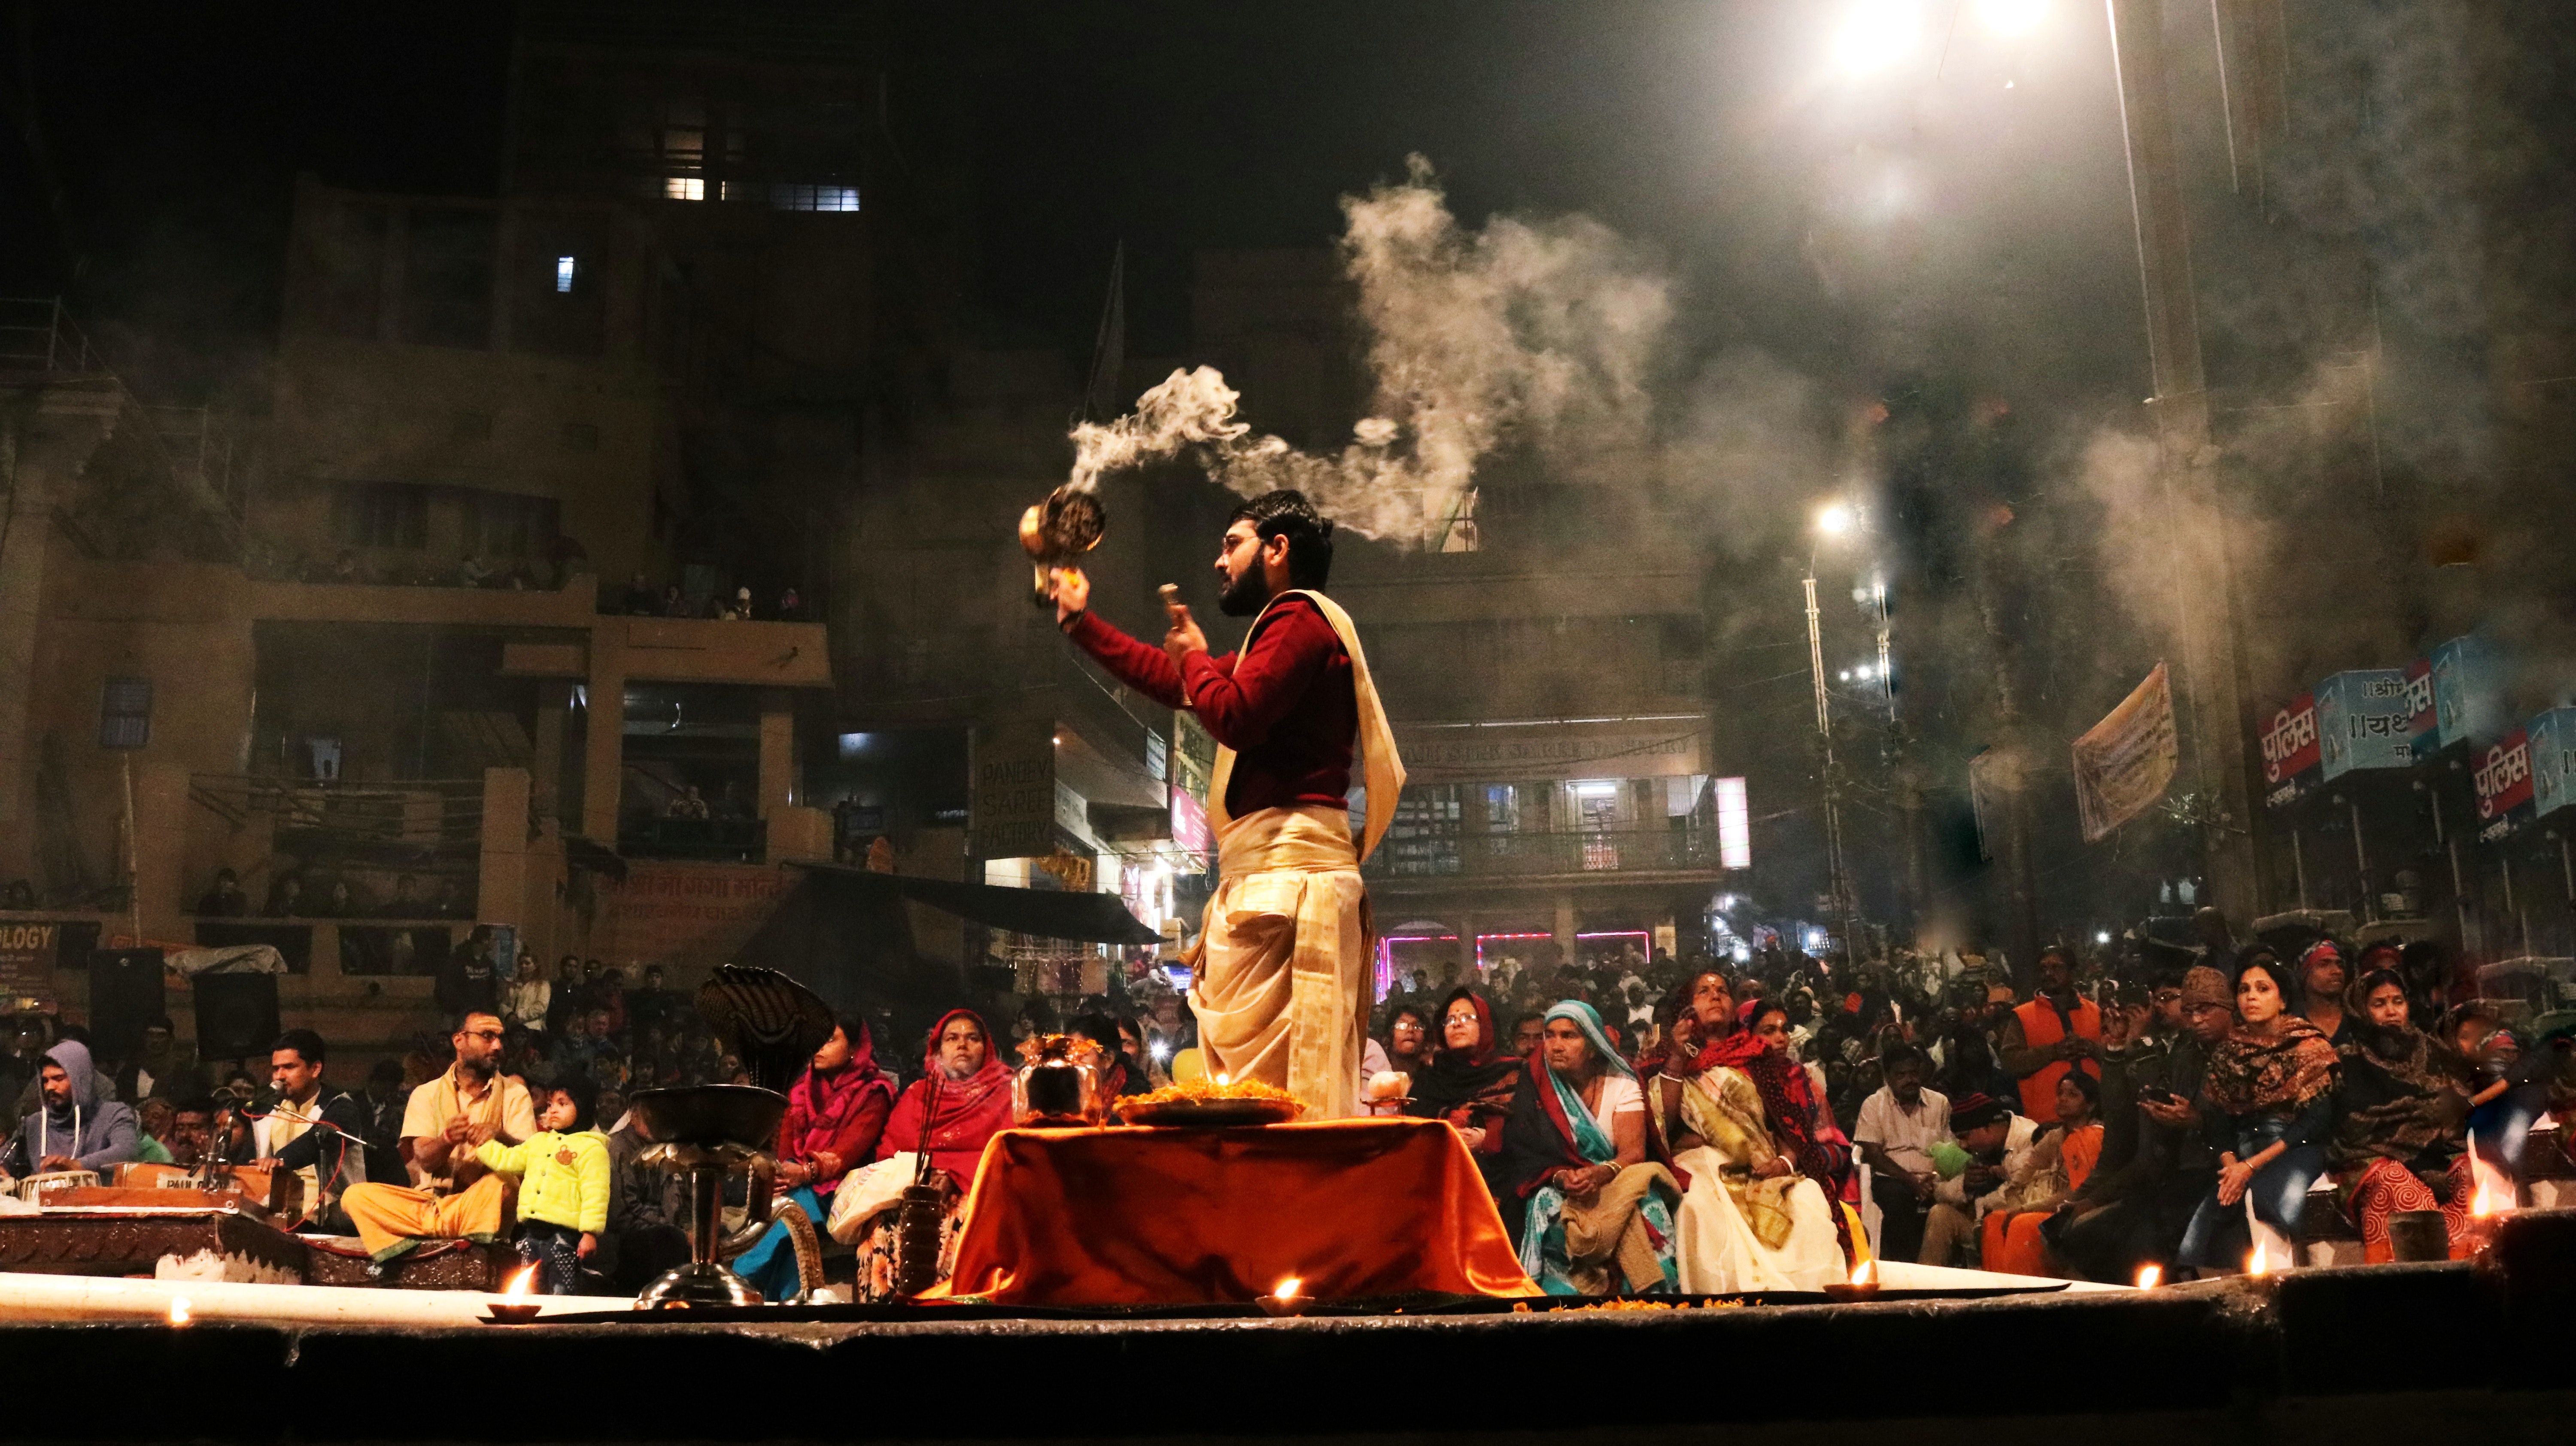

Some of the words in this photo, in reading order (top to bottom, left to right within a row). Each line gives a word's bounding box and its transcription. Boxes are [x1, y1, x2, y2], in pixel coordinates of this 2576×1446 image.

[2261, 708, 2316, 784] पुलिस
[982, 759, 1048, 786] PANDEY
[2474, 742, 2529, 819] पुलिस
[983, 788, 1048, 817] SAREE
[981, 819, 1048, 847] FACTORY
[0, 926, 52, 950] LOGY
